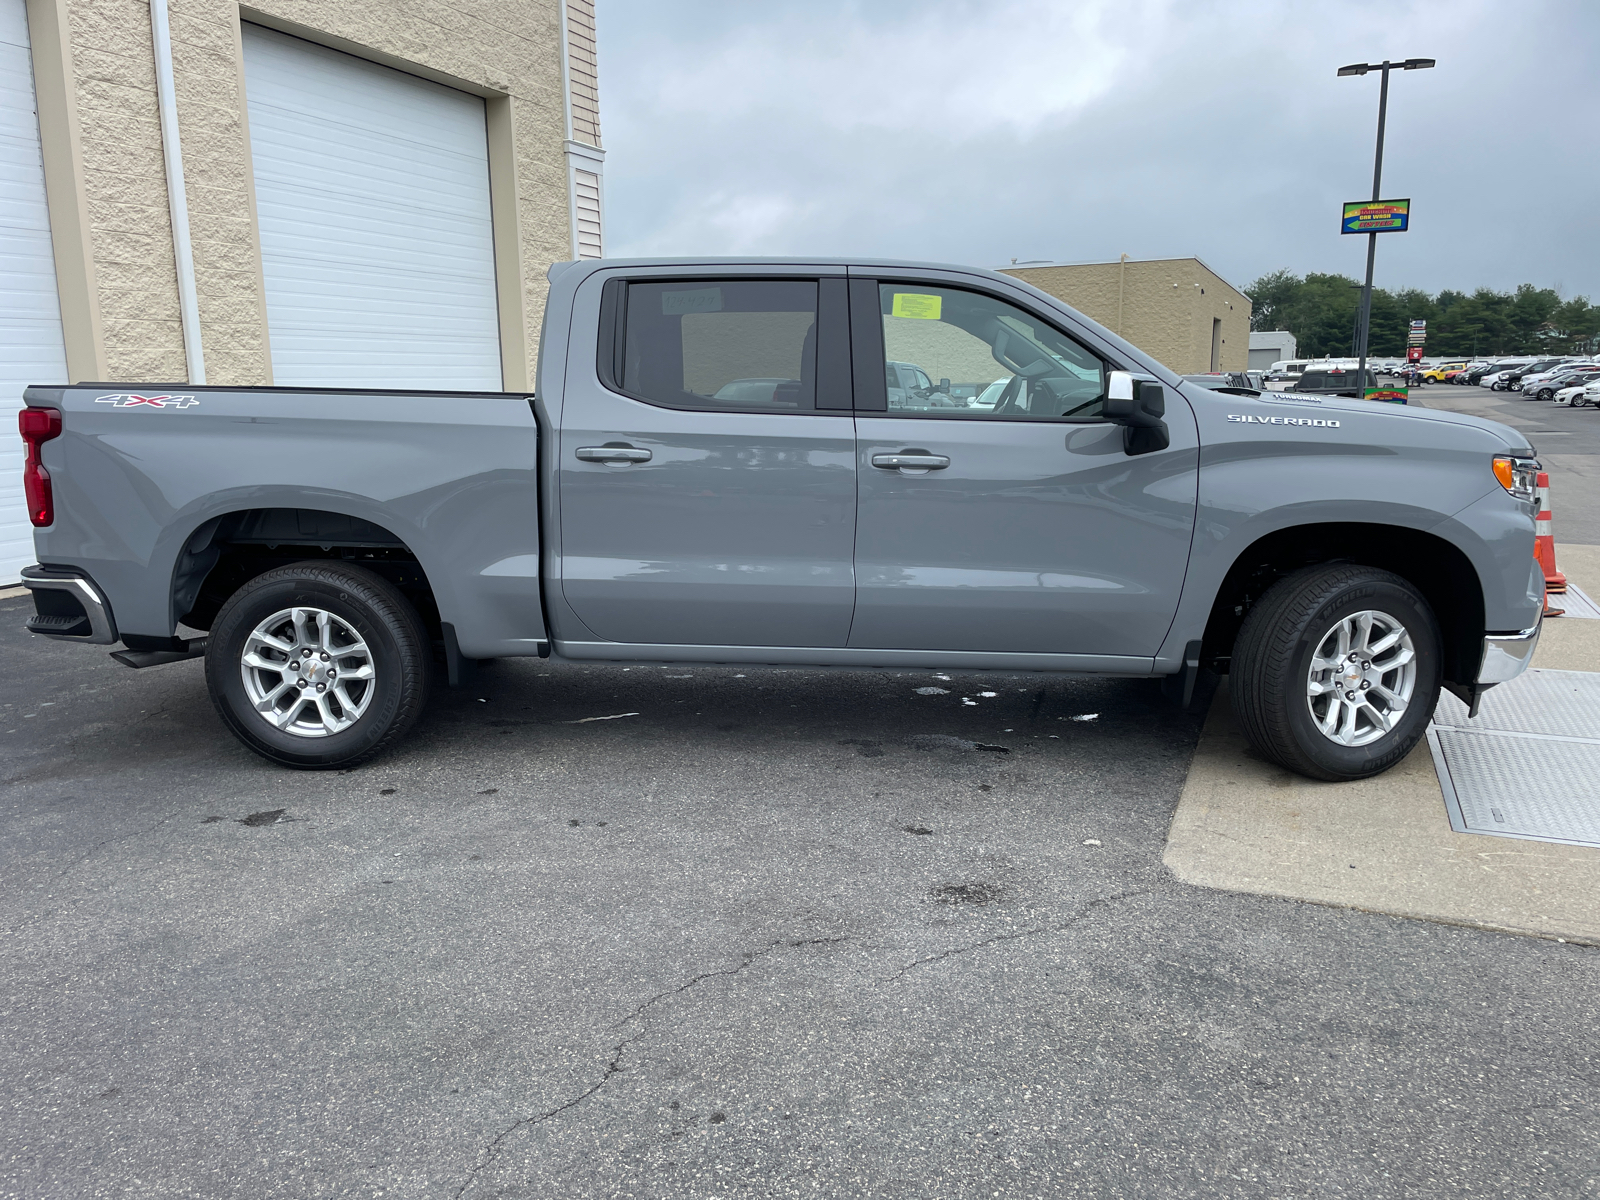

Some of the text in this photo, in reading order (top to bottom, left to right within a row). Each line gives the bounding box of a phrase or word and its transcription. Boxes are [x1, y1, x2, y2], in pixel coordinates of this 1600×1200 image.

[1359, 220, 1393, 228] ENTER
[1273, 393, 1322, 403] TURBOMAX
[1227, 414, 1341, 428] SILVERADO
[1322, 586, 1375, 619] MICHELIN
[368, 681, 398, 738] MICHELIN
[1364, 737, 1411, 770] MICHELIN
